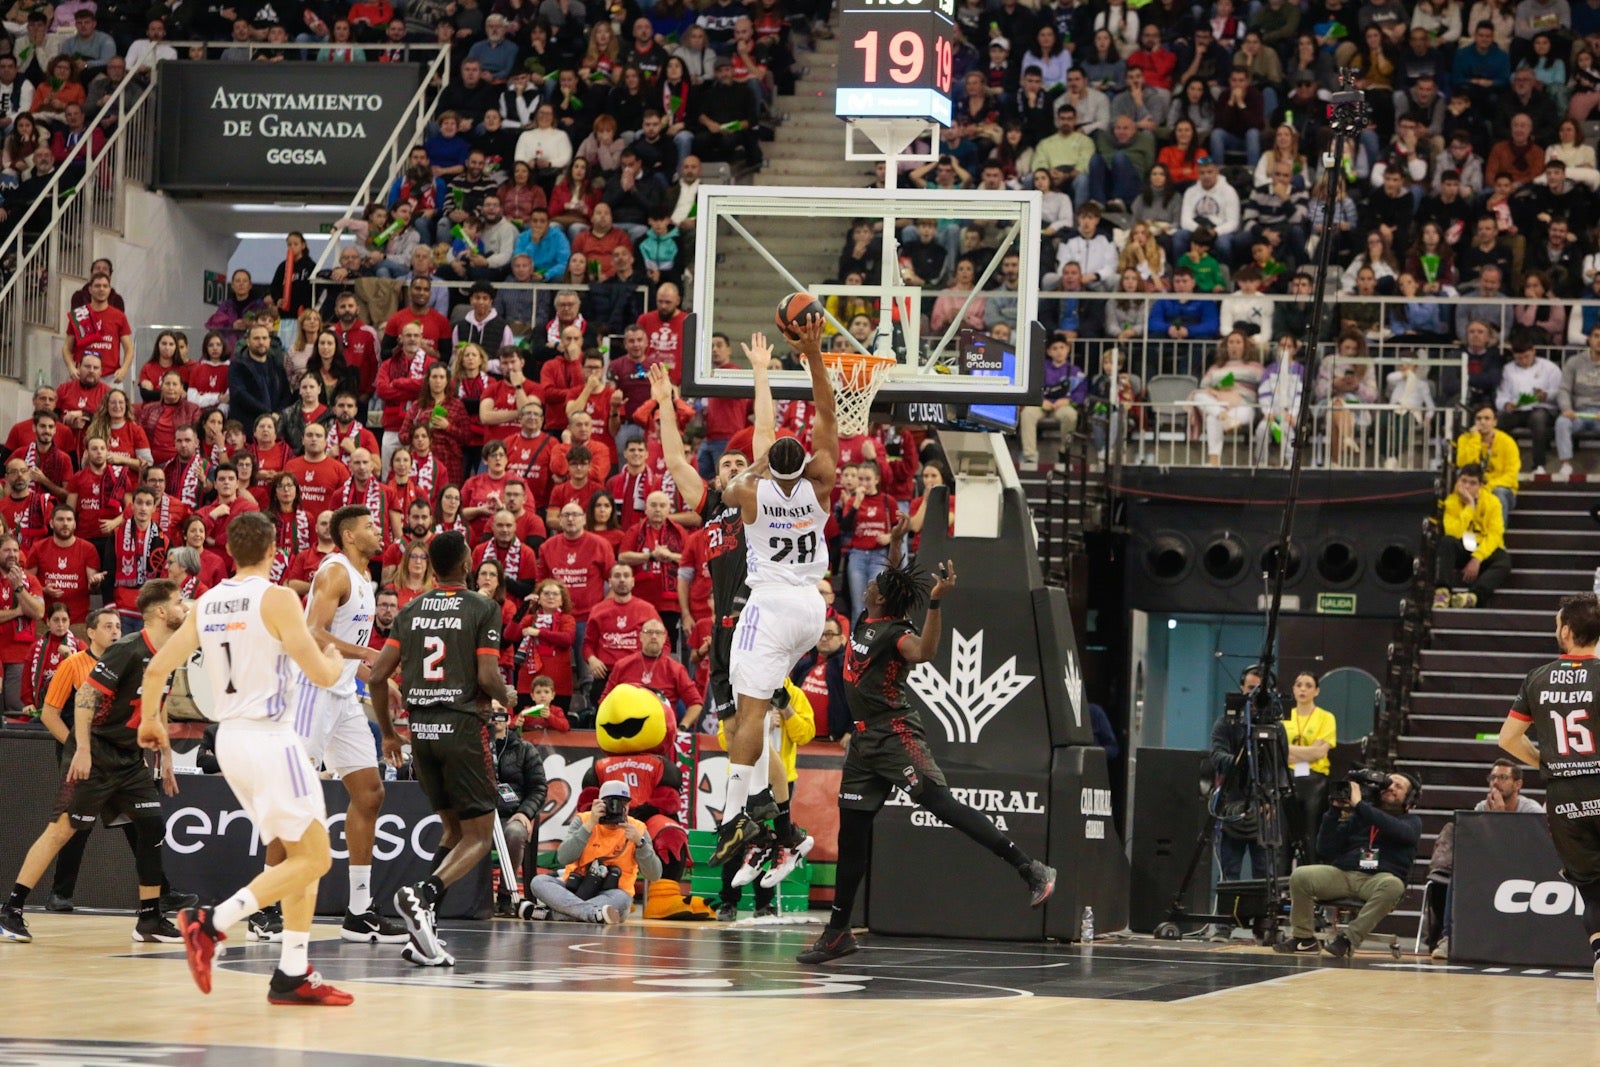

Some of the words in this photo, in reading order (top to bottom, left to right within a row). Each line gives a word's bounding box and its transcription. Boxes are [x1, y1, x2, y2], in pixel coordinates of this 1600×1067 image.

[854, 30, 925, 84] 19
[935, 35, 952, 93] 19
[210, 86, 384, 111] AYUNTAMIENTO
[223, 120, 252, 137] DE
[259, 113, 367, 139] GRANADA
[966, 351, 983, 362] liga
[966, 359, 1002, 369] endesa
[763, 503, 815, 519] YABUSELE
[708, 528, 723, 548] 21
[769, 530, 817, 564] 28
[421, 597, 464, 612] MOORE
[411, 616, 462, 631] PULEVA
[220, 641, 238, 695] 1
[422, 635, 447, 682] 2
[1549, 669, 1588, 685] COSTA
[1539, 690, 1594, 705] PULEVA
[1549, 708, 1596, 757] 15
[949, 787, 1045, 815] RURAL
